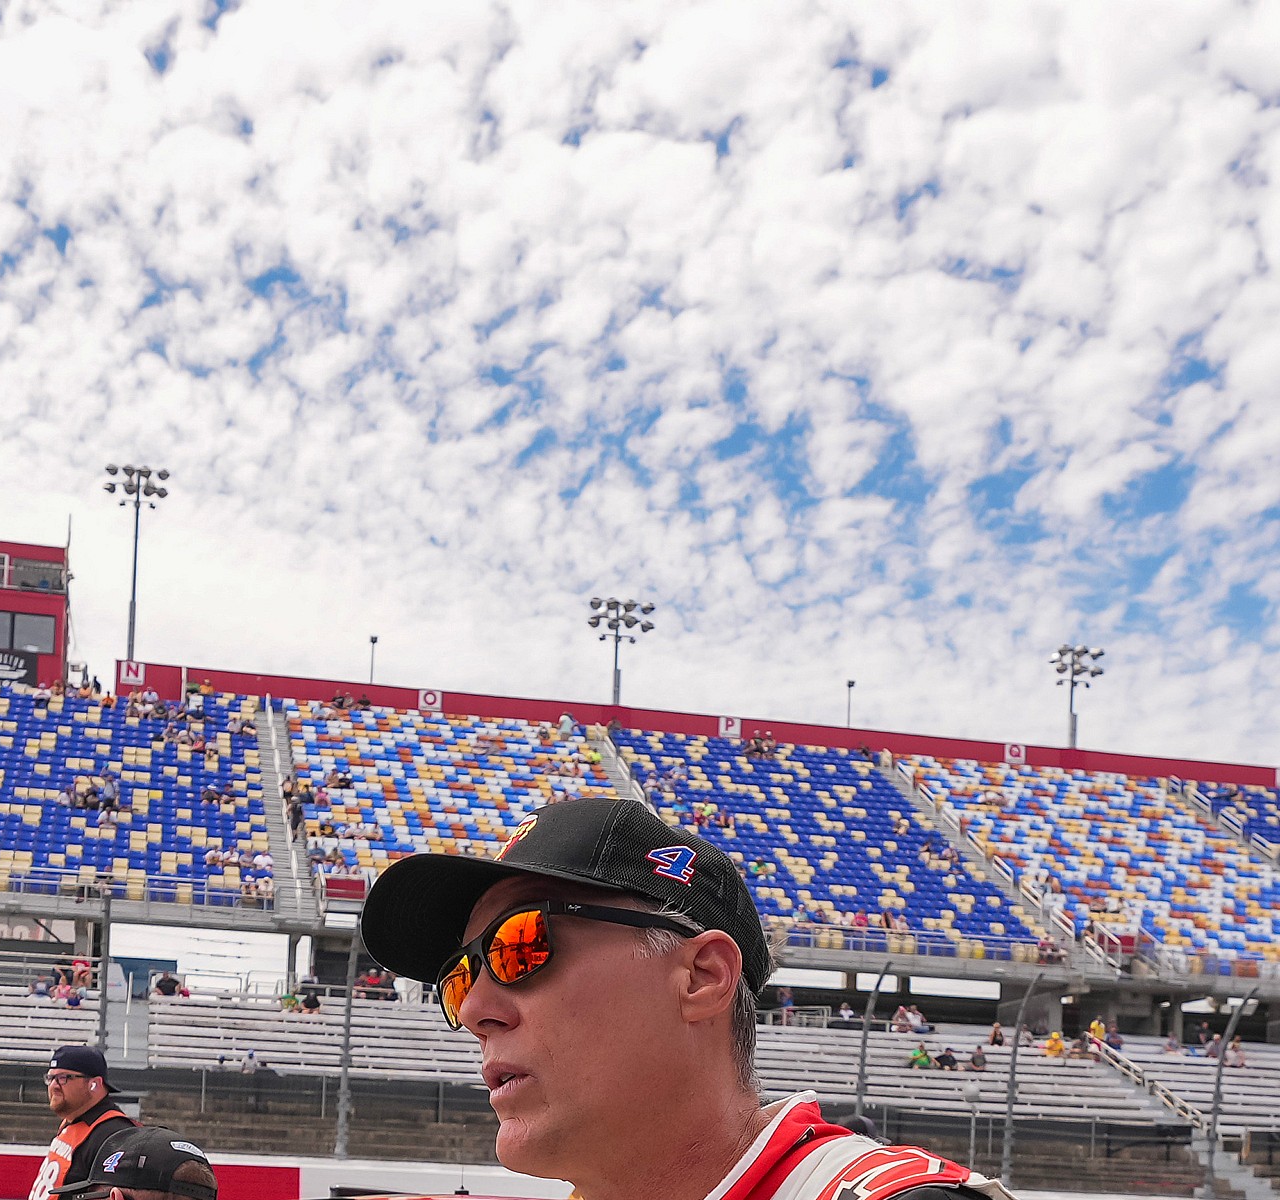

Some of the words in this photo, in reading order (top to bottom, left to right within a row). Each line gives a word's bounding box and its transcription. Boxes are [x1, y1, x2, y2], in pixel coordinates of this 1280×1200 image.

[126, 663, 139, 678] N
[725, 717, 735, 731] P
[644, 844, 698, 885] 4
[103, 1151, 125, 1173] 4
